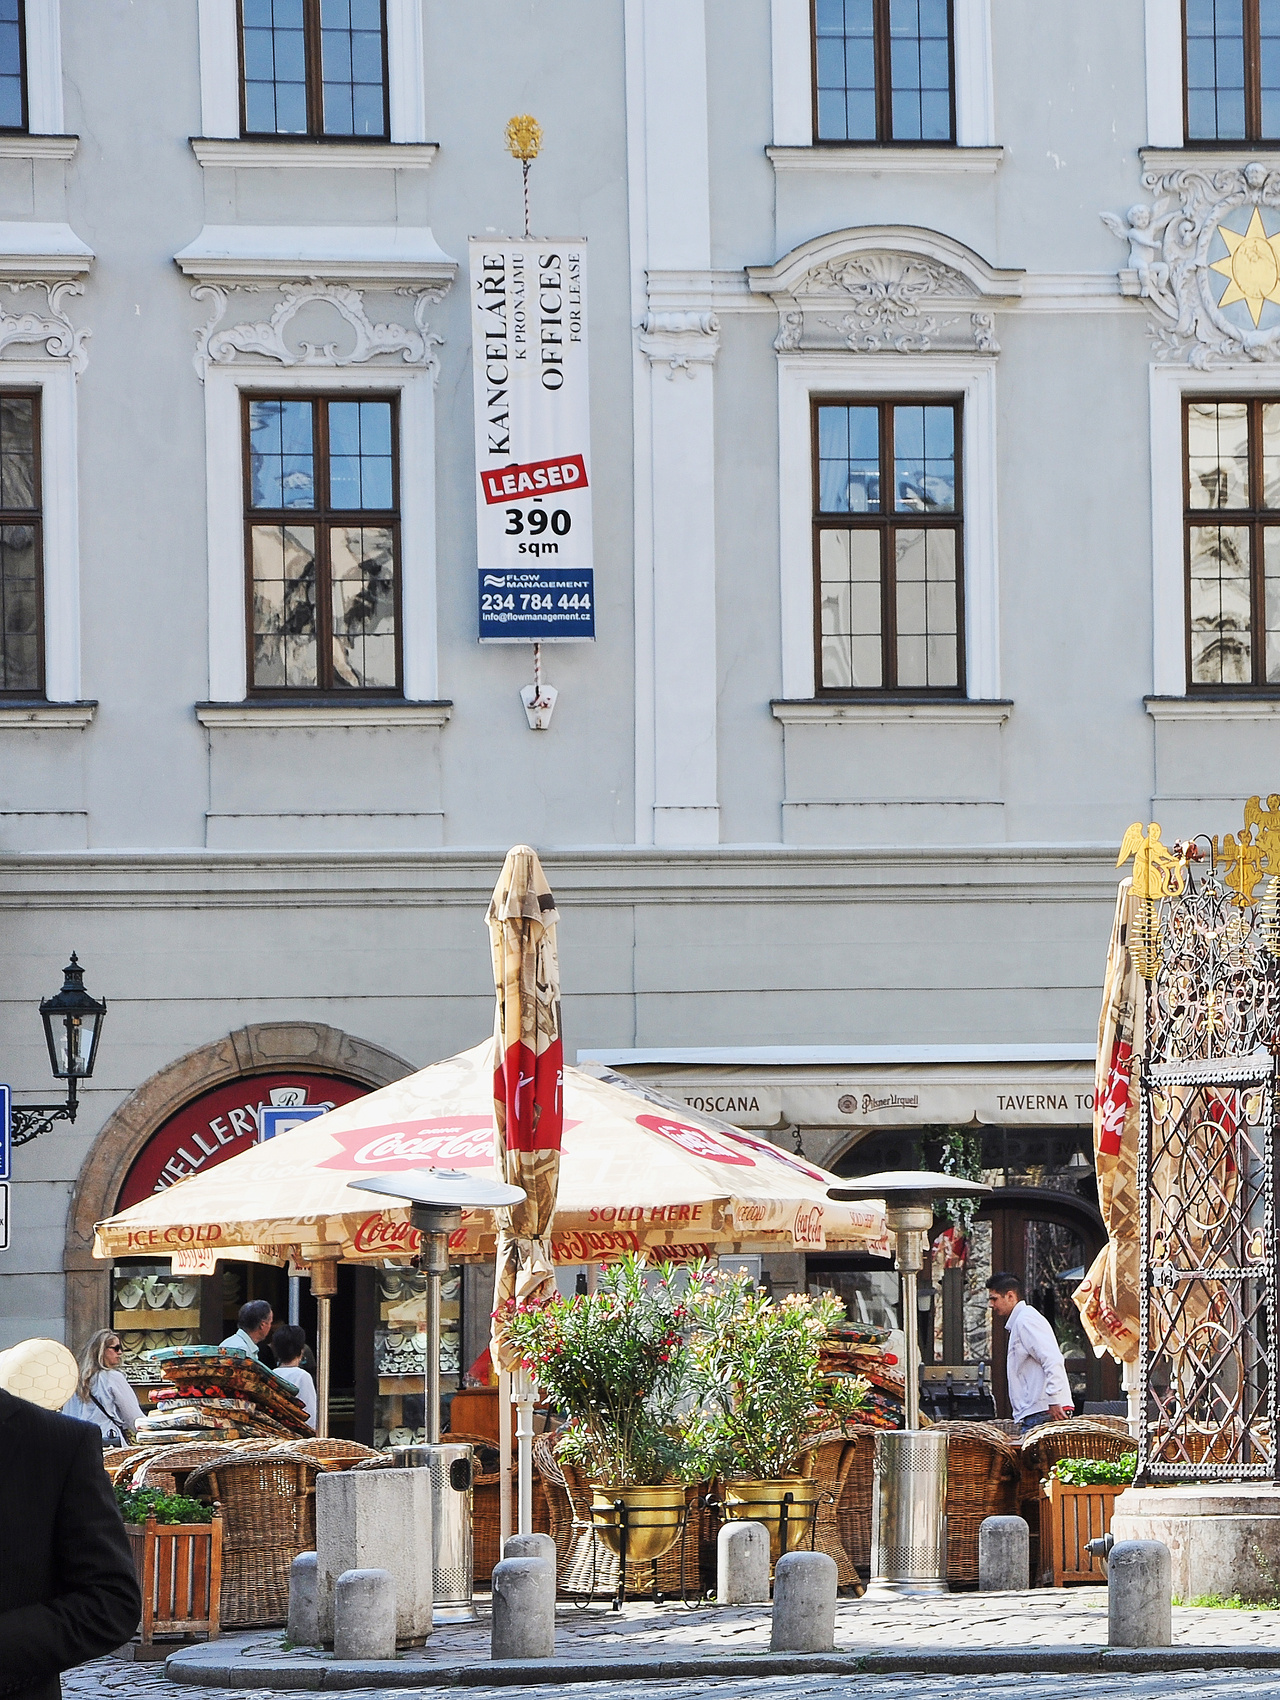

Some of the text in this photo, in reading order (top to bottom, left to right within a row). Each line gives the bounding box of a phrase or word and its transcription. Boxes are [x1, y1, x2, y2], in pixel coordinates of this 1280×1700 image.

[510, 253, 526, 359] K PRONÁJMU
[568, 253, 582, 342] FOR LEASE
[538, 253, 564, 391] OFFICES
[476, 253, 510, 455] KANCELÁŘE
[488, 463, 580, 497] LEASED
[505, 508, 571, 536] 390
[518, 542, 559, 557] sqm
[481, 593, 591, 610] 234 784 444
[482, 612, 591, 622] info@flowmanagement.cz
[684, 1097, 760, 1112] TOSCANA
[997, 1094, 1068, 1110] TAVERNA
[588, 1204, 703, 1222] SOLD HERE
[127, 1229, 158, 1247] ICE
[163, 1224, 222, 1244] COLD
